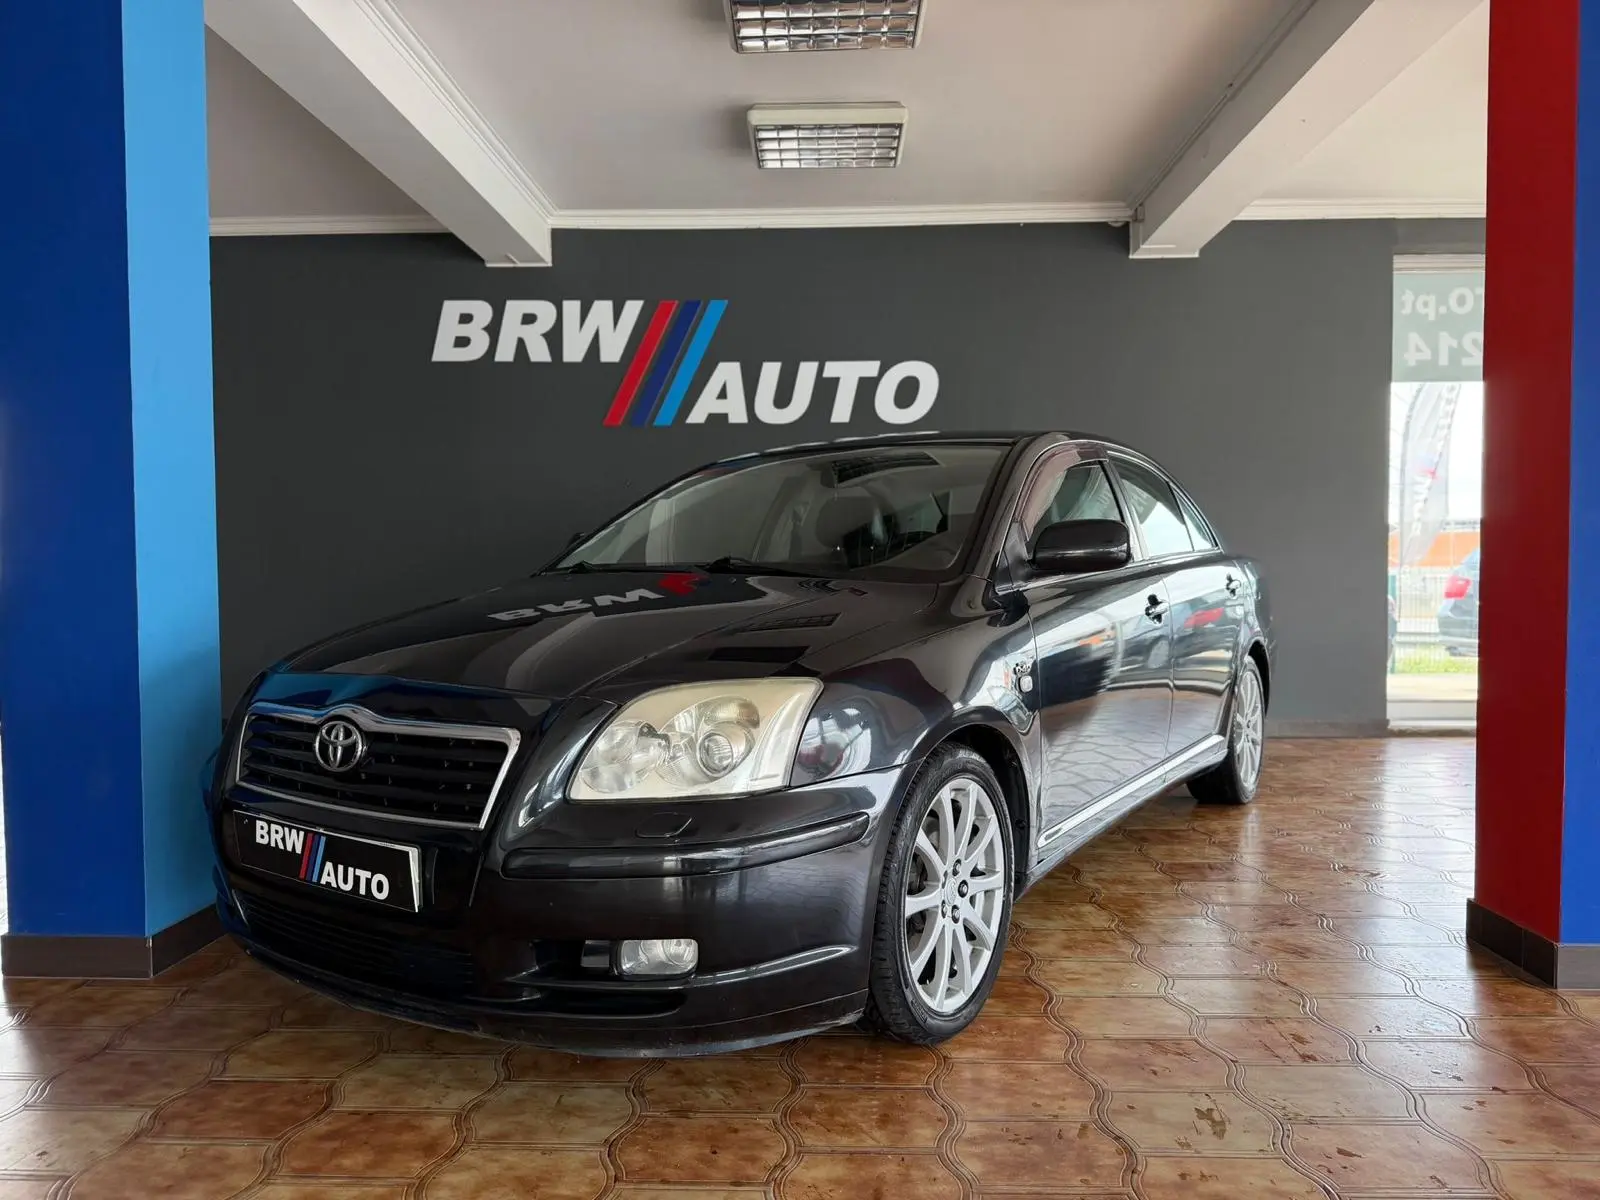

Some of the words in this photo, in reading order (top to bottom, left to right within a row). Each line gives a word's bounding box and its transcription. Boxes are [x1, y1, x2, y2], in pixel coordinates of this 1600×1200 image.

[431, 299, 645, 363] BRW
[685, 360, 940, 425] AUTO
[255, 819, 305, 855] BRW
[320, 861, 390, 900] AUTO
